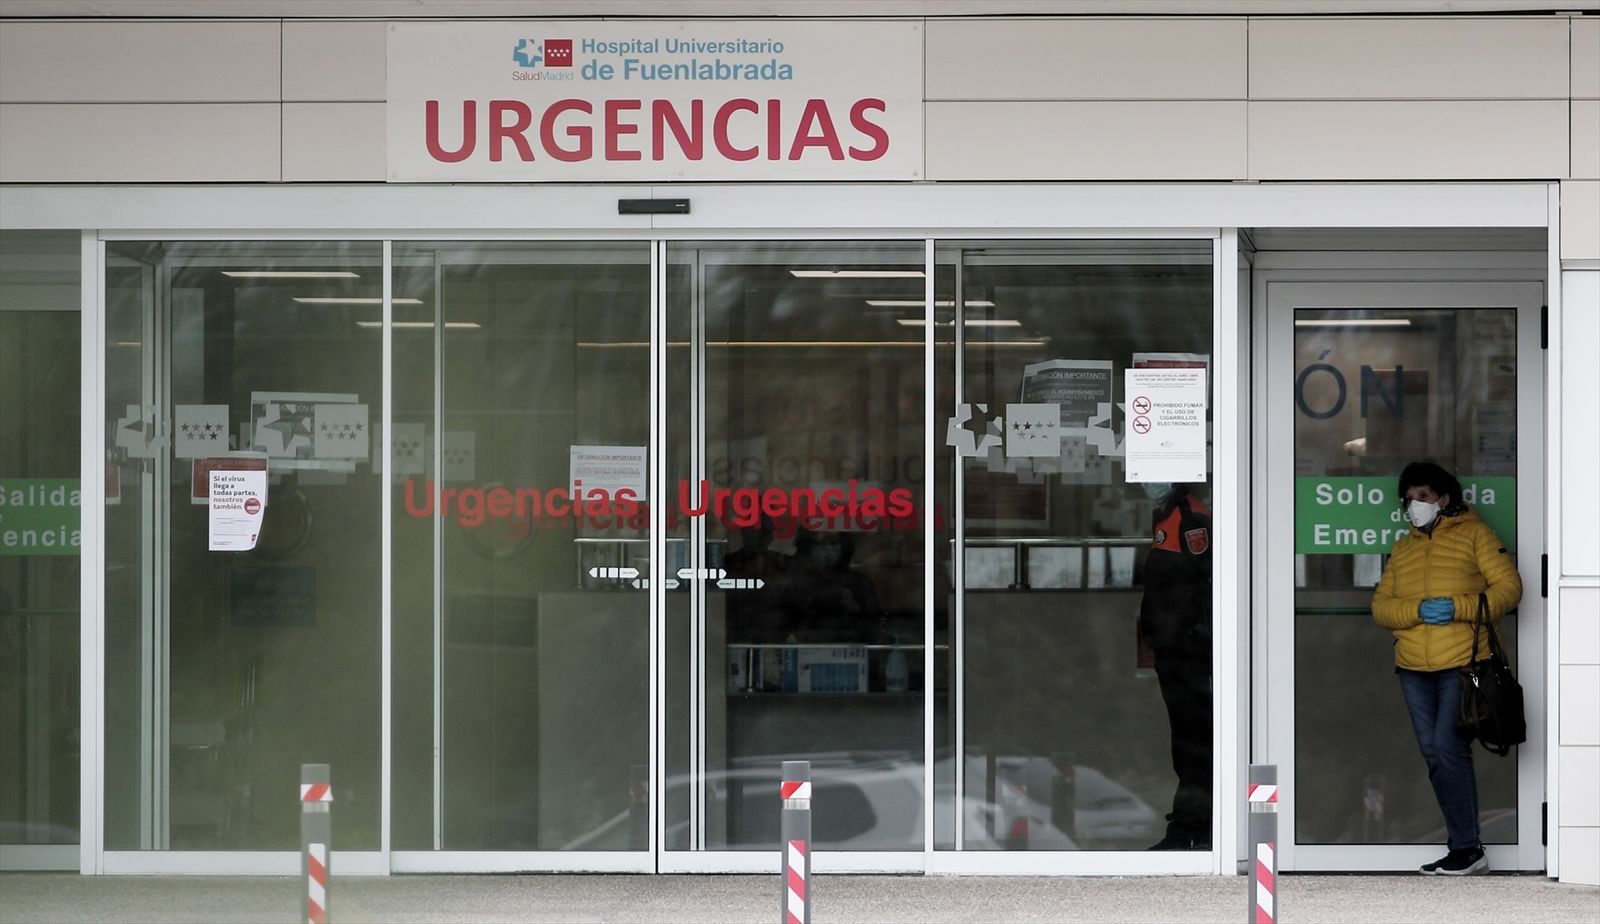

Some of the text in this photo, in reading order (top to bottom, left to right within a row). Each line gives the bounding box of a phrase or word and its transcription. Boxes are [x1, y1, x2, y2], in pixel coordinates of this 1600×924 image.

[581, 38, 784, 60] Hospital Universitario
[512, 70, 574, 81] SaludMadrid
[581, 59, 793, 81] de Fuenlabrada
[425, 98, 890, 163] URGENCIAS
[405, 480, 637, 527] Urgencias
[678, 479, 913, 526] Urgencias
[1315, 483, 1384, 505] Solo
